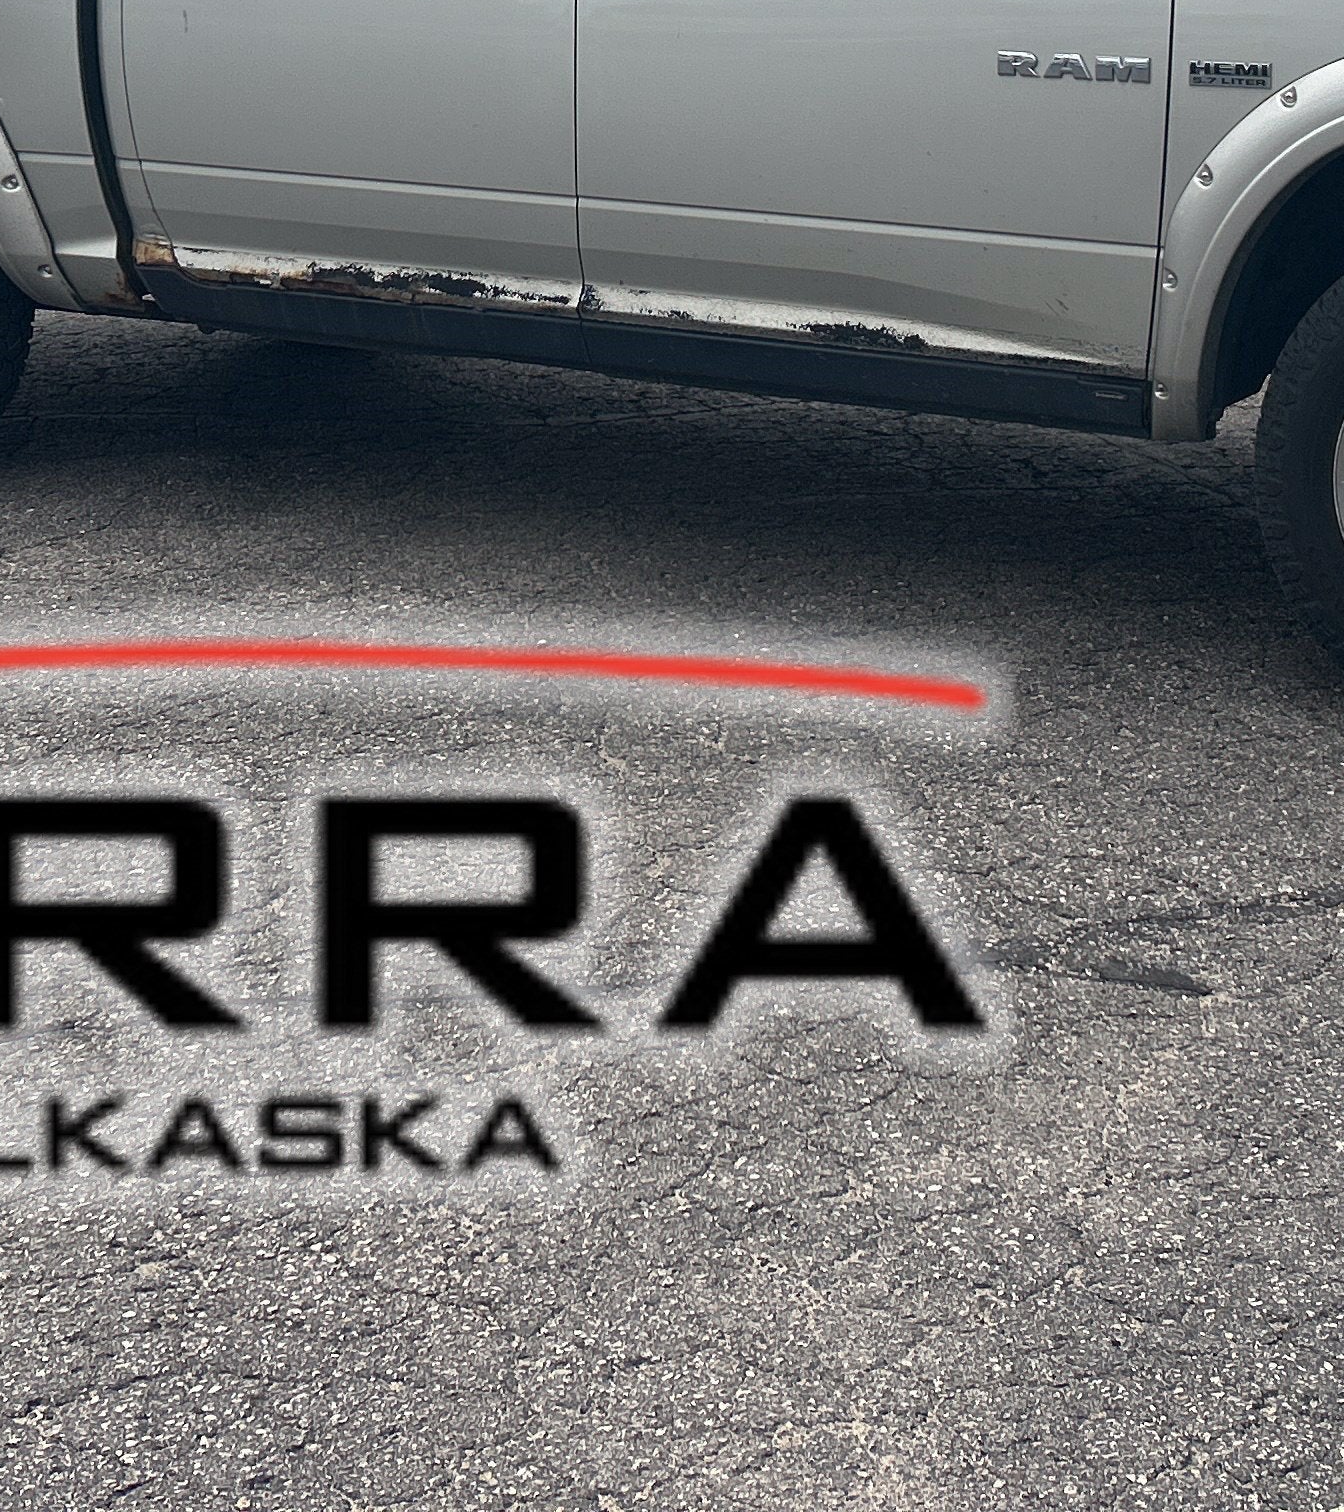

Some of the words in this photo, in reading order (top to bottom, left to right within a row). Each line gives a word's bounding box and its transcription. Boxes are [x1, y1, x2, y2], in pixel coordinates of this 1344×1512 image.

[997, 49, 1152, 84] RAM
[1189, 60, 1269, 77] HEMI
[1221, 77, 1266, 86] LITER
